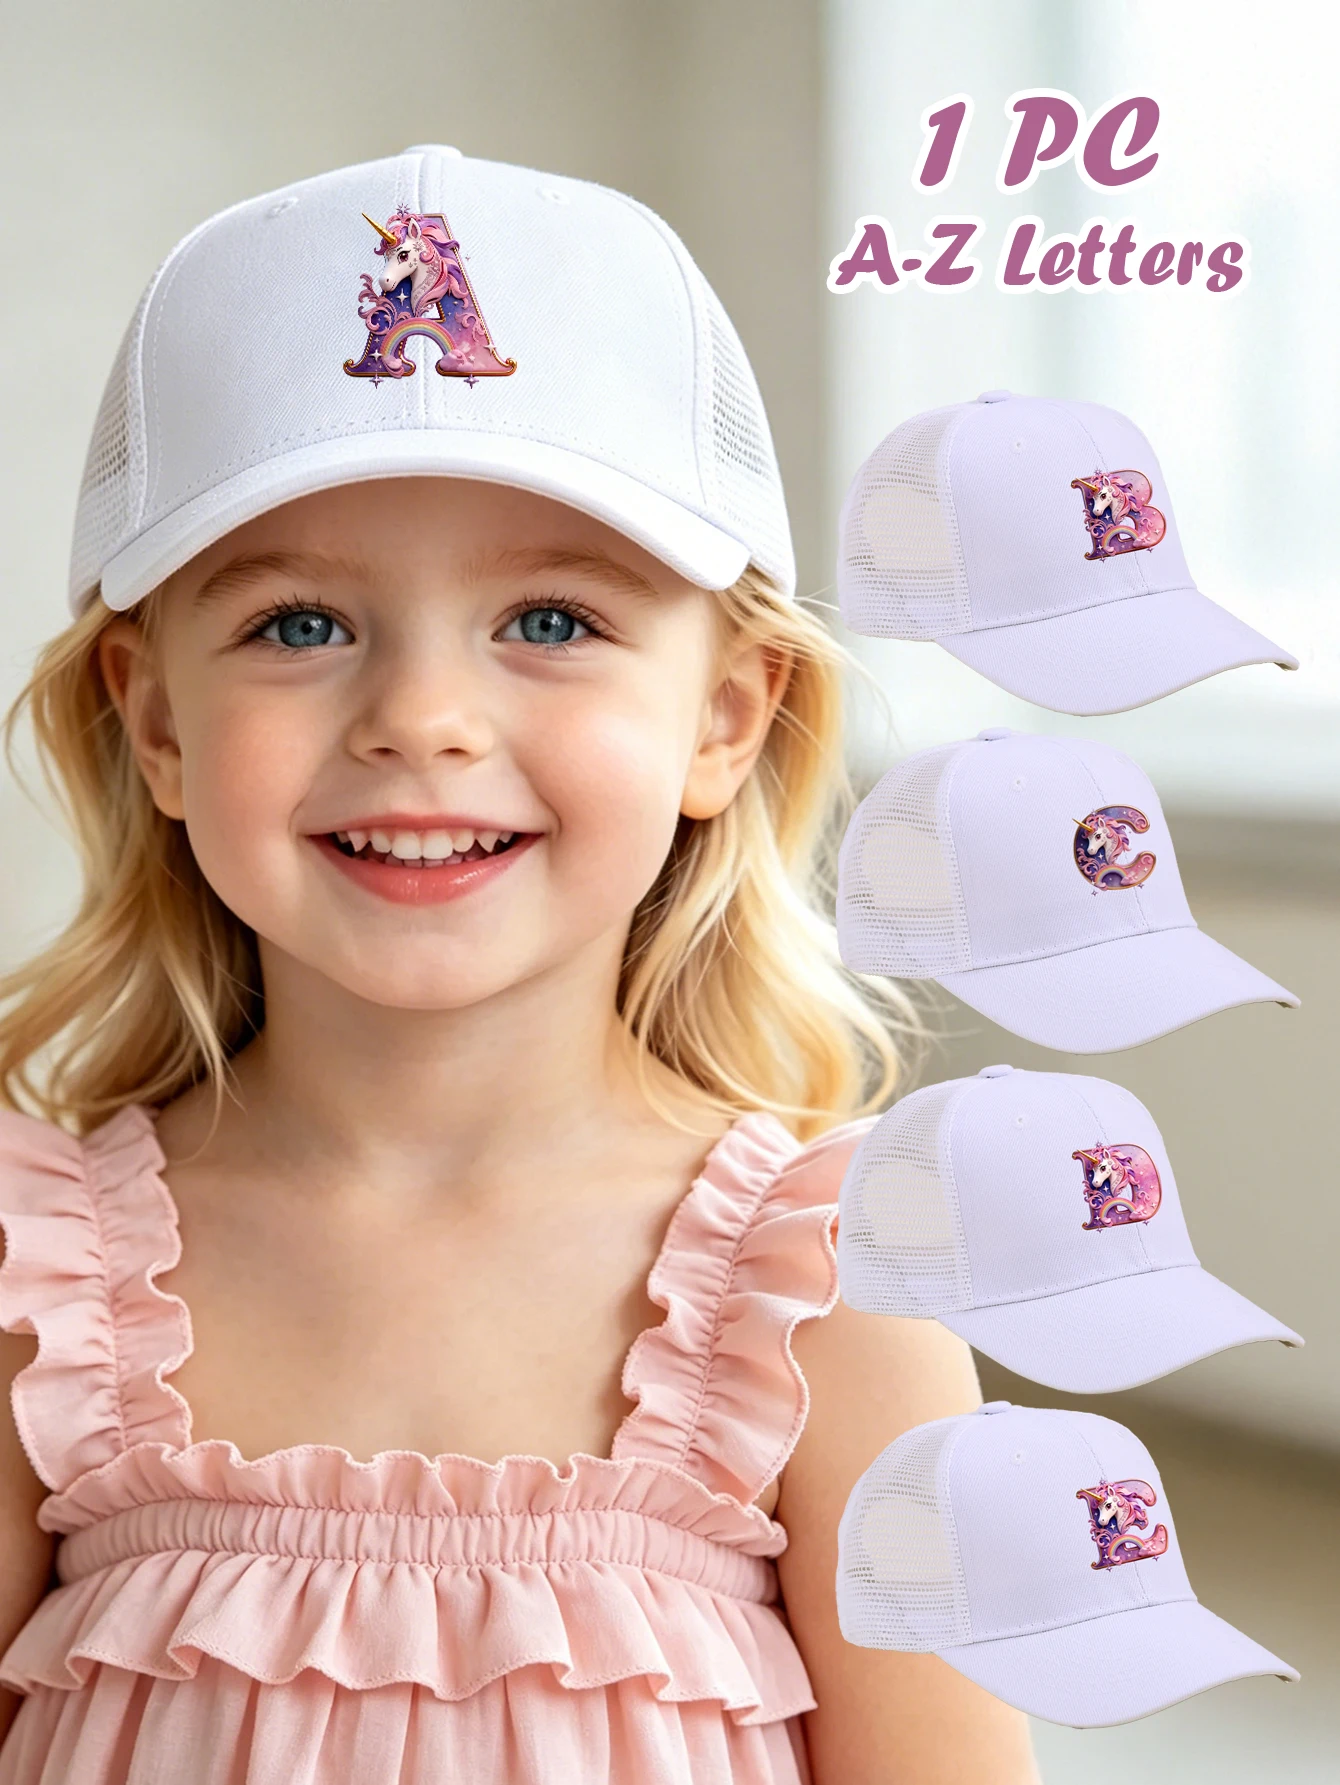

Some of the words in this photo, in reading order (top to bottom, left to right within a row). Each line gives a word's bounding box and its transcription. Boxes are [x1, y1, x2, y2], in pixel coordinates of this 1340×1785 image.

[343, 212, 517, 377] A
[1070, 470, 1167, 560] B
[1073, 805, 1157, 890] C
[1071, 1144, 1162, 1230] D
[1076, 1479, 1169, 1570] E
